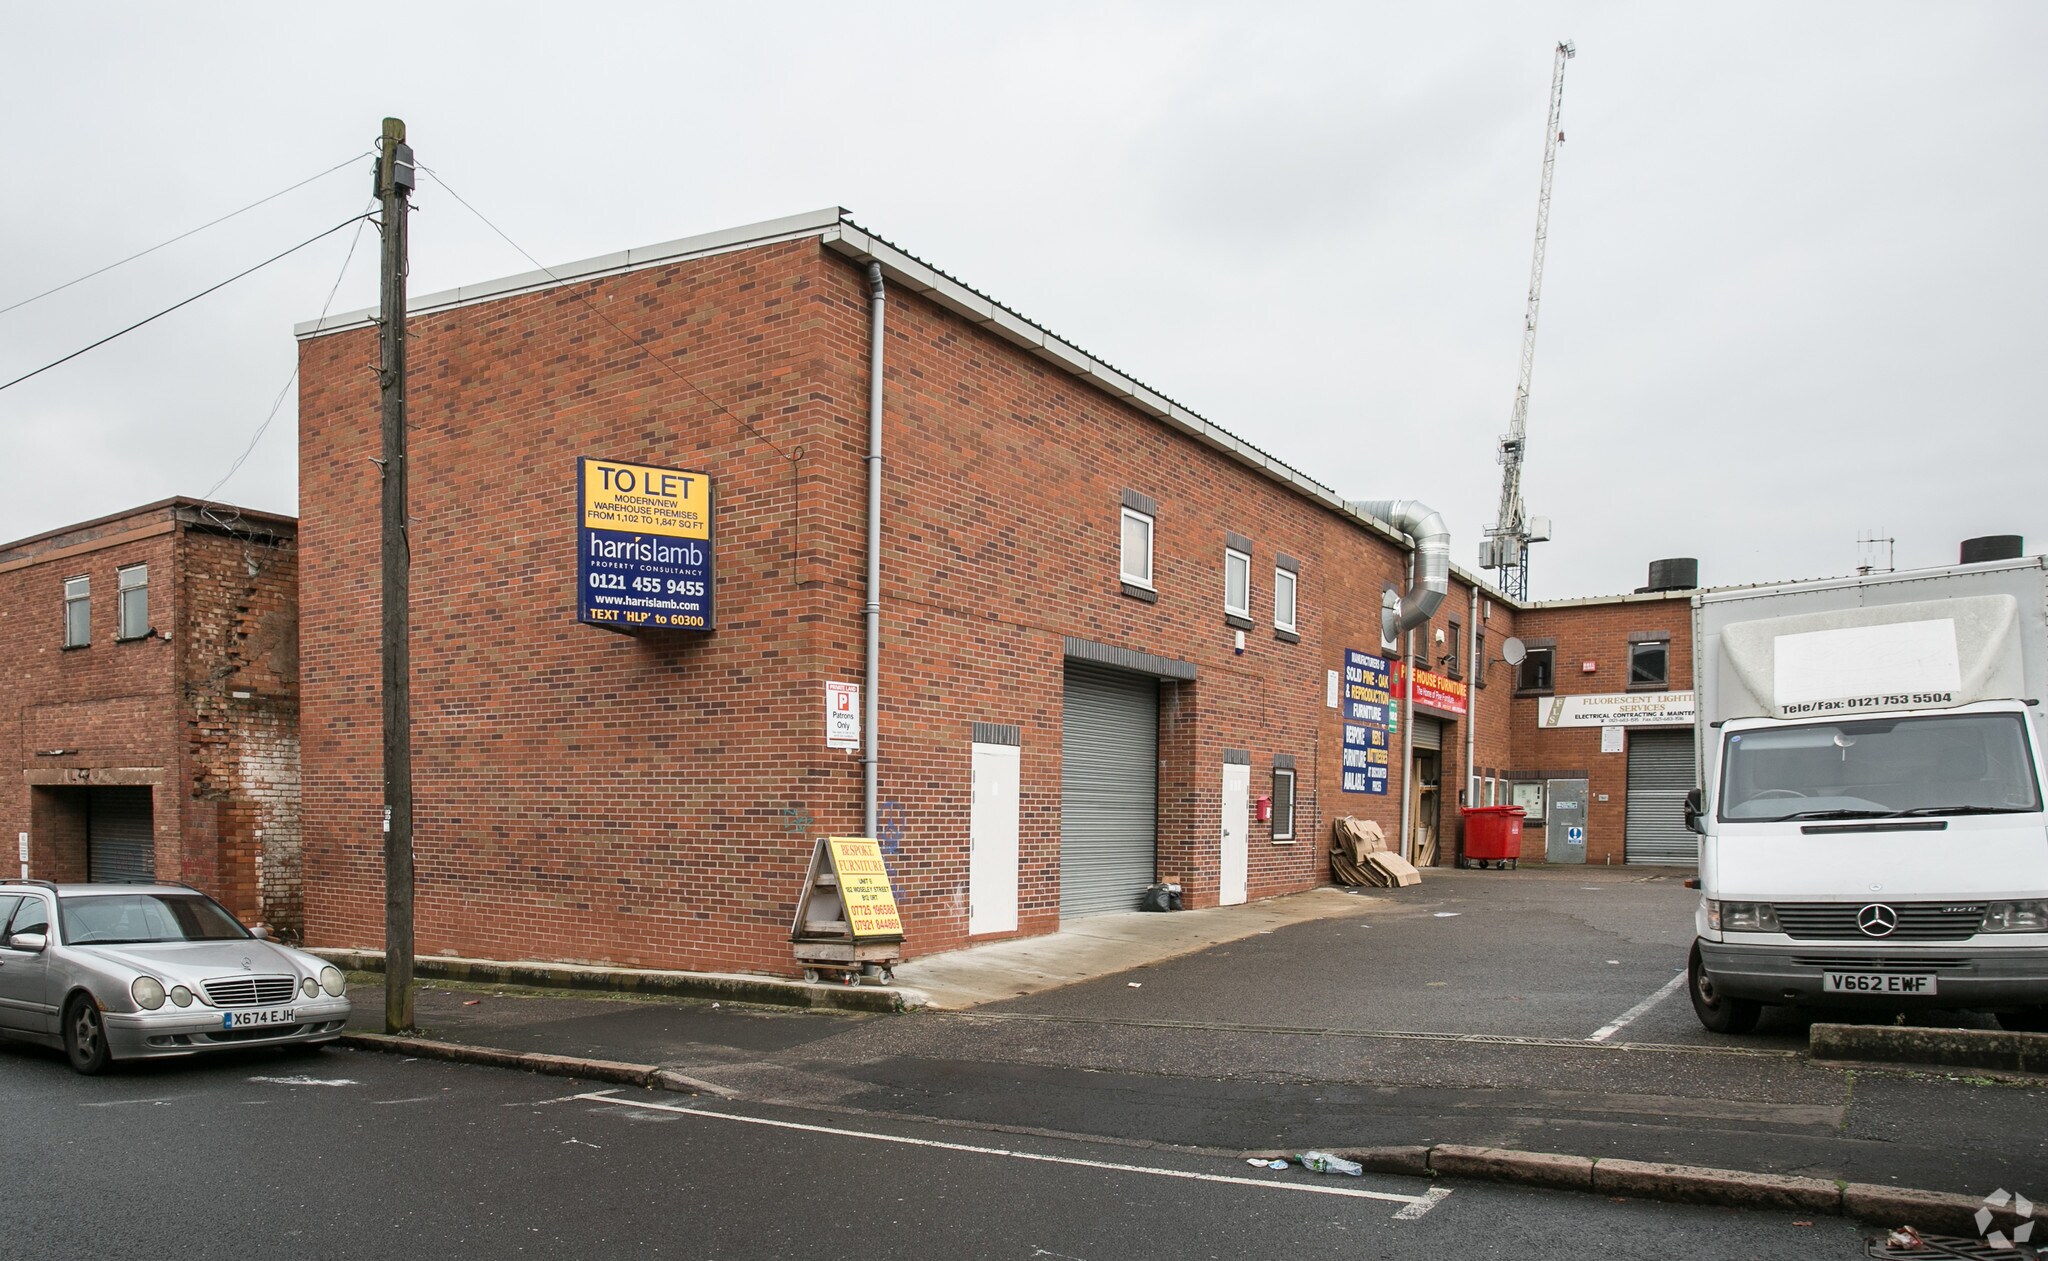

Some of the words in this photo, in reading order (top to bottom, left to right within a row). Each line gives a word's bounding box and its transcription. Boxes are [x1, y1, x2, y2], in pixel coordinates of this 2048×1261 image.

[598, 466, 636, 492] TO
[644, 472, 694, 499] LET
[614, 494, 678, 508] MODERN/NEW
[594, 502, 652, 516] WAREHOUSE
[654, 507, 698, 520] PREMISES
[588, 510, 614, 521] FROM
[617, 514, 638, 524] 1,102
[641, 516, 652, 525] TO
[656, 517, 676, 528] 1,847
[679, 520, 691, 529] SQ
[693, 522, 704, 530] FT
[591, 532, 702, 566] harrislamb
[591, 561, 634, 570] PROPERTY
[640, 564, 702, 576] CONSULTANCY
[590, 572, 626, 590] 0121
[632, 576, 661, 592] 455
[666, 579, 704, 596] 9455
[595, 594, 700, 611] www.harrislamb.com
[590, 608, 619, 620] TEXT
[655, 614, 667, 624] to
[670, 615, 704, 627] 60300
[1346, 666, 1362, 683] SOLID
[1363, 670, 1375, 686] PINE
[1378, 674, 1389, 688] OAK
[1416, 670, 1437, 688] HOUSE
[1437, 676, 1467, 696] FURNITURE
[839, 693, 848, 709] P
[1345, 683, 1350, 698] &
[1351, 684, 1389, 705] REPRODUCTION
[1583, 696, 1652, 705] FLUORESCENT
[1353, 702, 1382, 721] FURNITURE
[1620, 704, 1666, 712] SERVICES
[1782, 700, 1844, 714] Tele/Fax:
[1848, 696, 1880, 708] 0121
[1883, 694, 1909, 705] 753
[1913, 692, 1952, 704] 5504
[832, 711, 854, 720] Patrons
[837, 721, 850, 731] Only
[1346, 725, 1365, 745] BESPOKE
[1372, 730, 1381, 745] BEDS
[1344, 748, 1366, 768] FURNITURE
[1367, 748, 1388, 764] MATTRESSES
[1344, 772, 1365, 790] AVAILABLE
[840, 845, 874, 857] BESPOKE
[838, 860, 884, 872] FURNITURE
[851, 905, 872, 916] 07725
[854, 920, 875, 931] 07921
[1832, 975, 1882, 991] V662
[1889, 976, 1928, 992] EWF
[234, 1011, 267, 1025] X674
[271, 1009, 294, 1022] EJH
